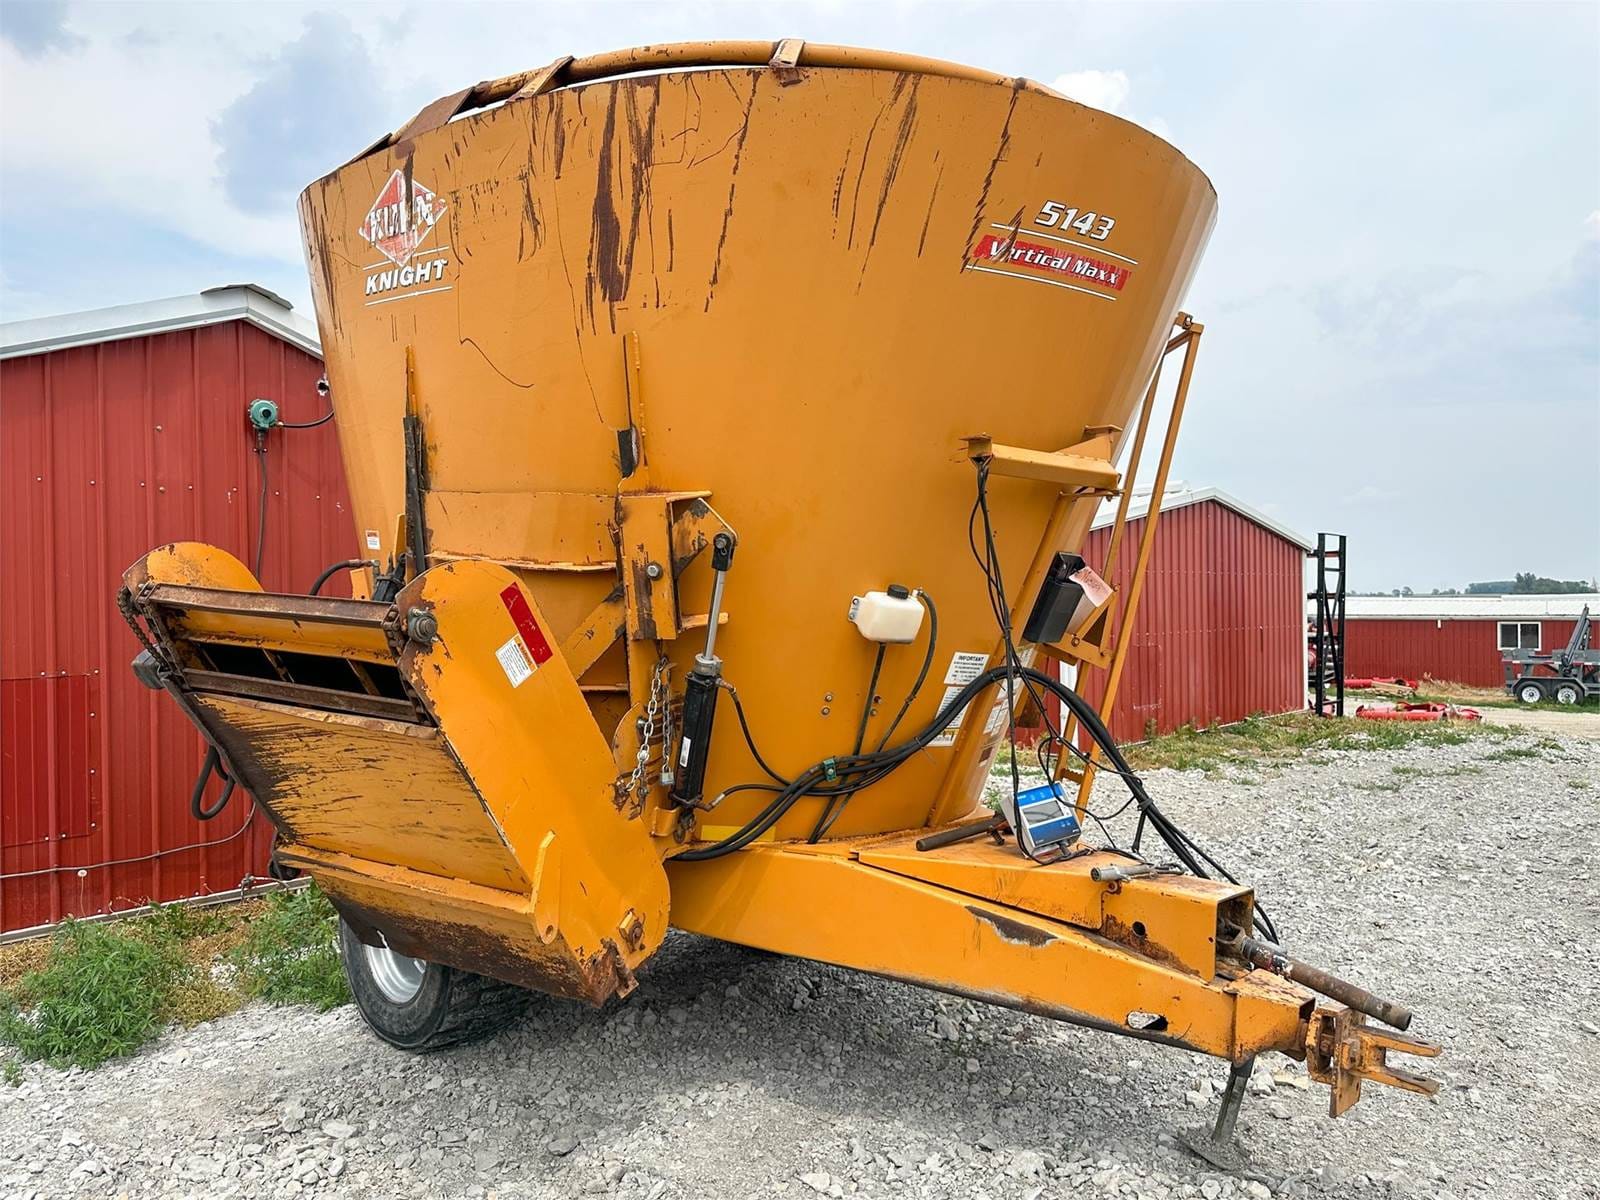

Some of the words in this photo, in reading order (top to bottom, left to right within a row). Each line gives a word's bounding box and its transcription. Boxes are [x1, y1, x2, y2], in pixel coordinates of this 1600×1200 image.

[1034, 200, 1115, 241] 5143
[366, 259, 448, 295] KNIGHT
[990, 241, 1072, 269] Vrtical
[1072, 259, 1120, 285] Maxx
